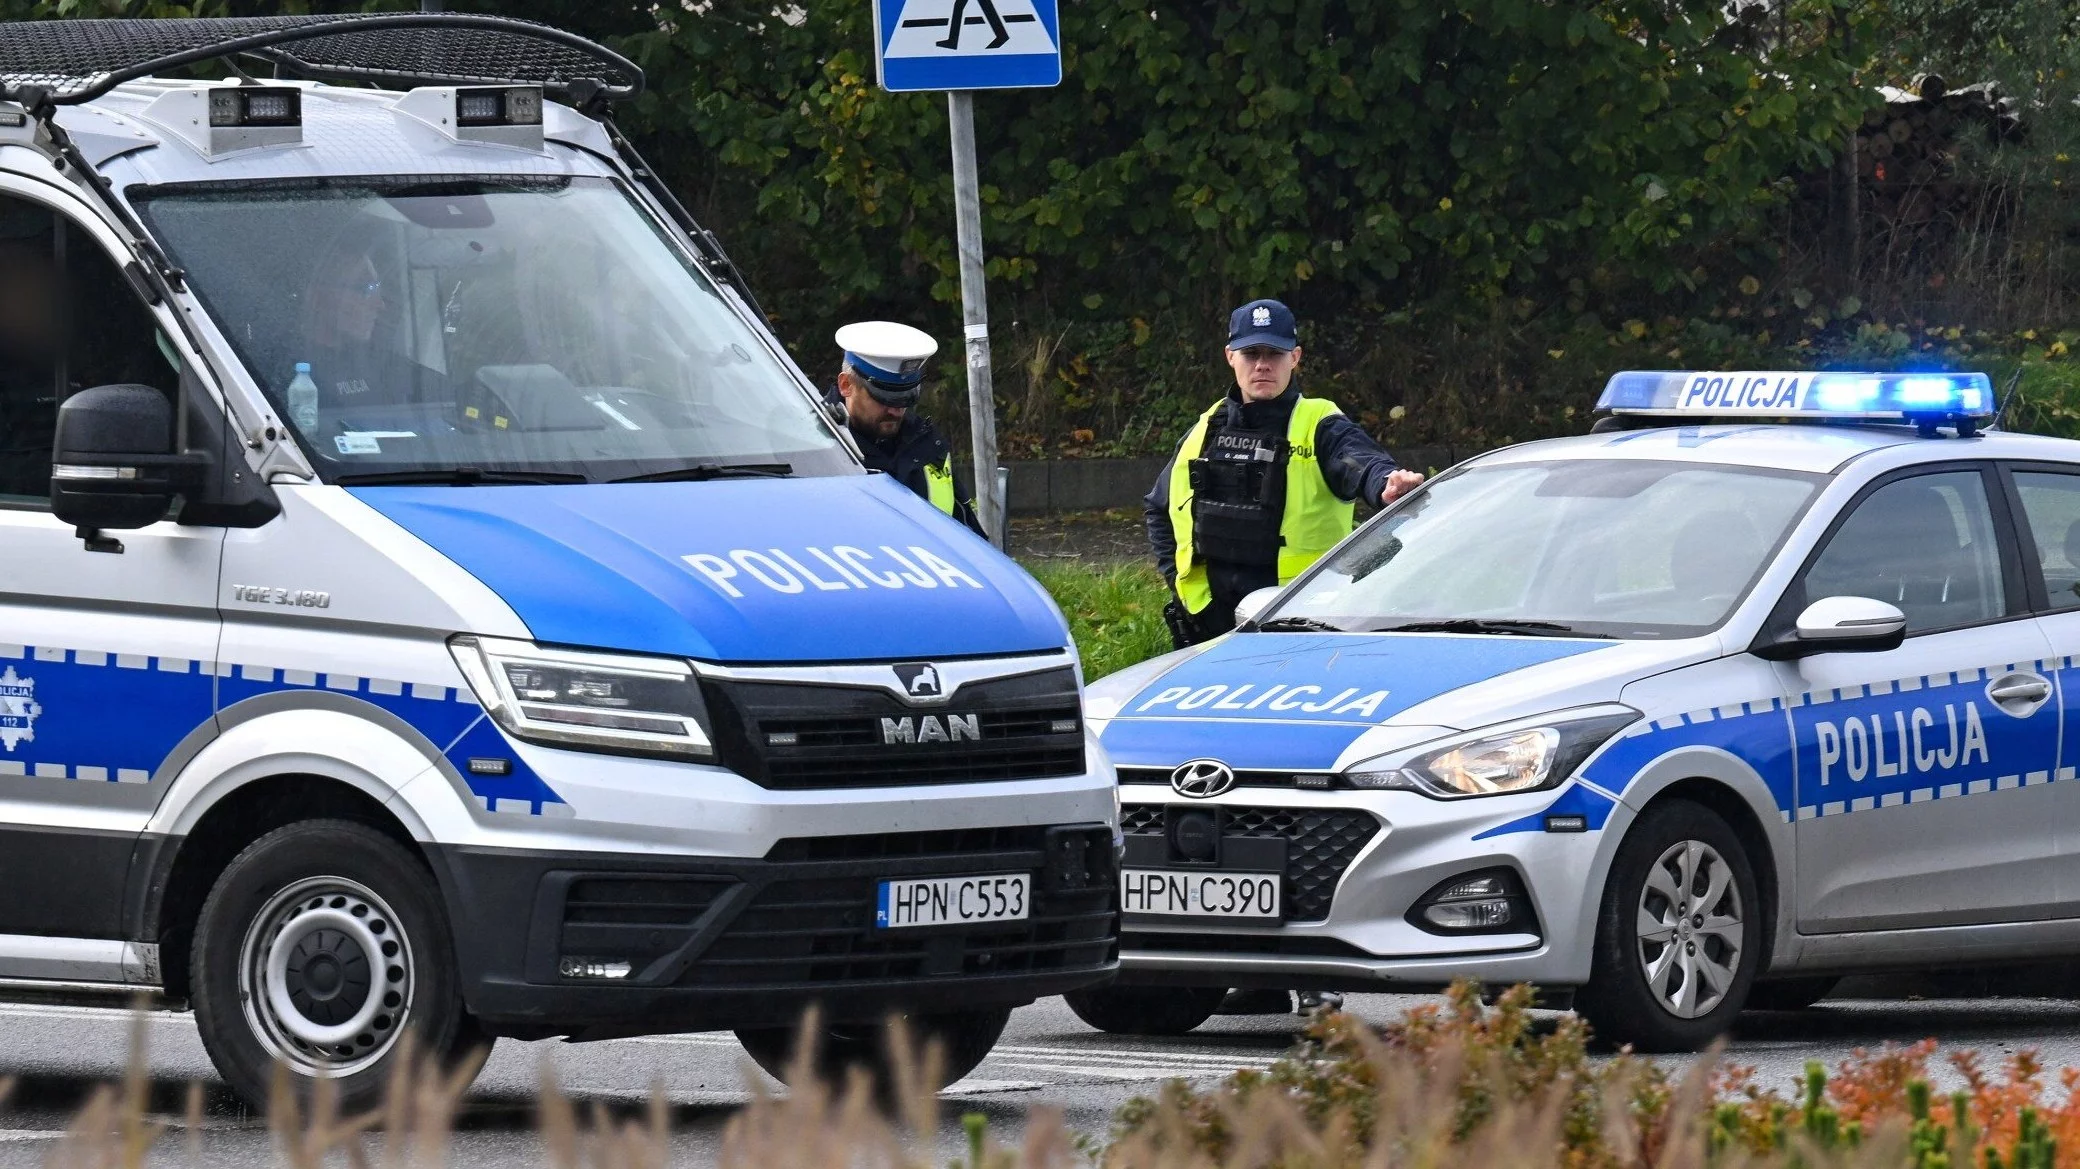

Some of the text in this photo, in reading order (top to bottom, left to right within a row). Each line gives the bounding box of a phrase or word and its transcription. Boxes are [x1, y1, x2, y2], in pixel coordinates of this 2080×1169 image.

[1685, 377, 1799, 408] POLICJA
[1217, 435, 1262, 450] POLICJA
[681, 545, 984, 598] POLICJA
[233, 584, 330, 608] TGE 3.180
[0, 686, 29, 697] OLICJA
[1136, 684, 1391, 717] POLICJA
[2, 716, 18, 727] 112
[881, 714, 981, 744] MAN
[1815, 701, 1989, 786] POLICJA
[896, 878, 1024, 923] HPN C553
[1125, 874, 1275, 915] HPN C390
[877, 910, 888, 921] PL
